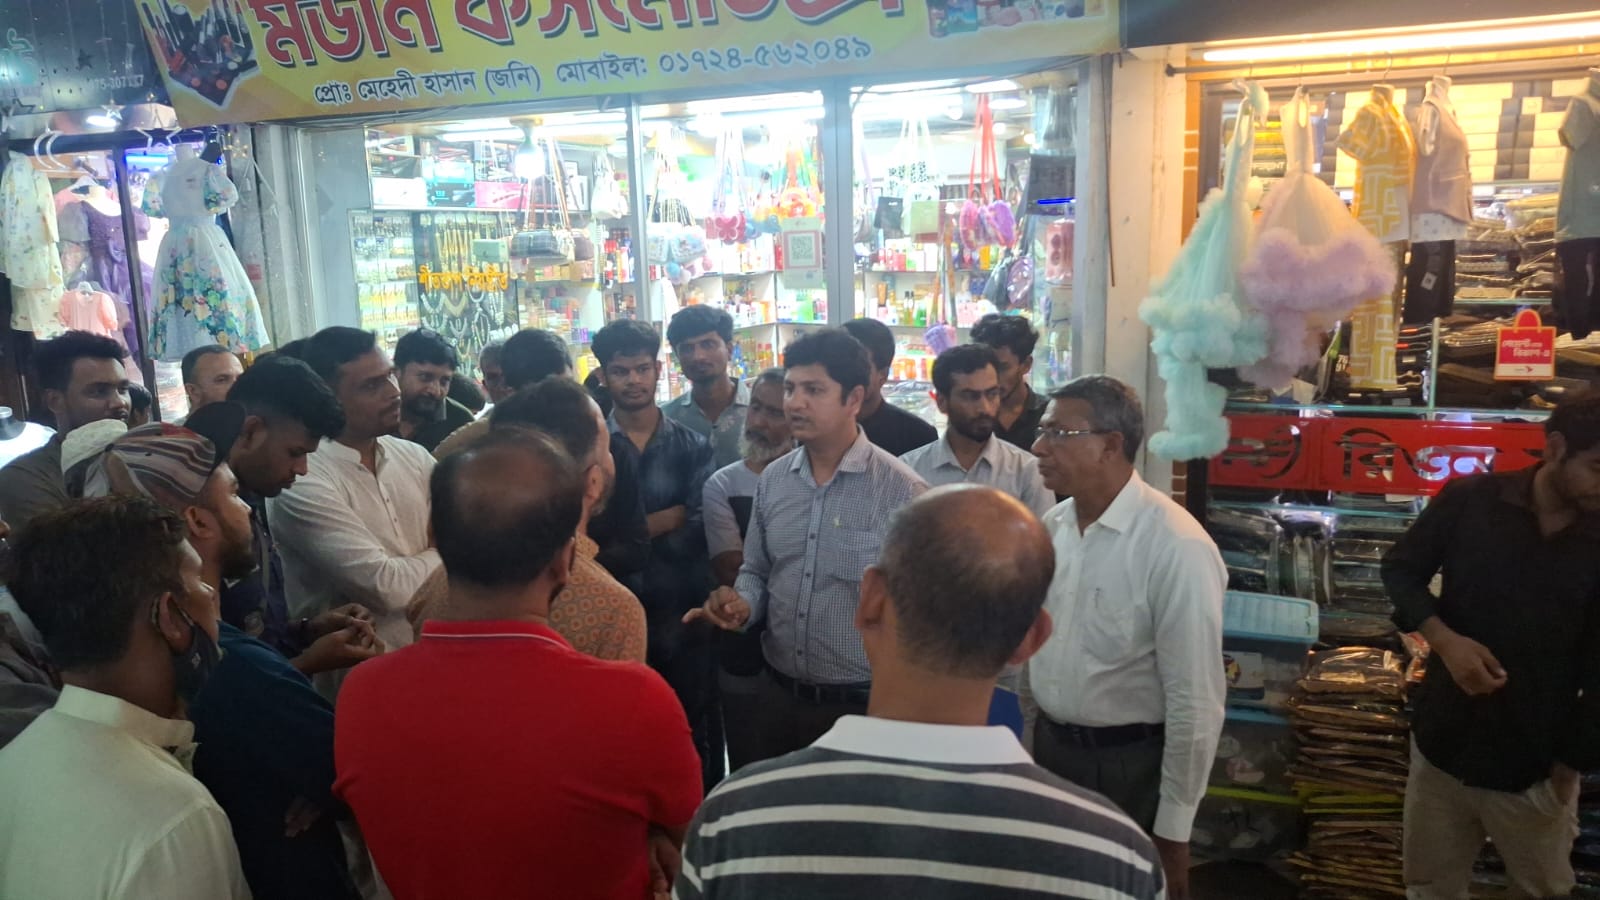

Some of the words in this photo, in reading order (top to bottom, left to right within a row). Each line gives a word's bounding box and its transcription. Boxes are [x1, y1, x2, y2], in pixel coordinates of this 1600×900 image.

[358, 69, 417, 98] মেহেদী
[419, 71, 476, 94] হাসান
[485, 60, 540, 96] (জনি)
[658, 37, 872, 73] ০১৭২৪-৫৬২০৪৯
